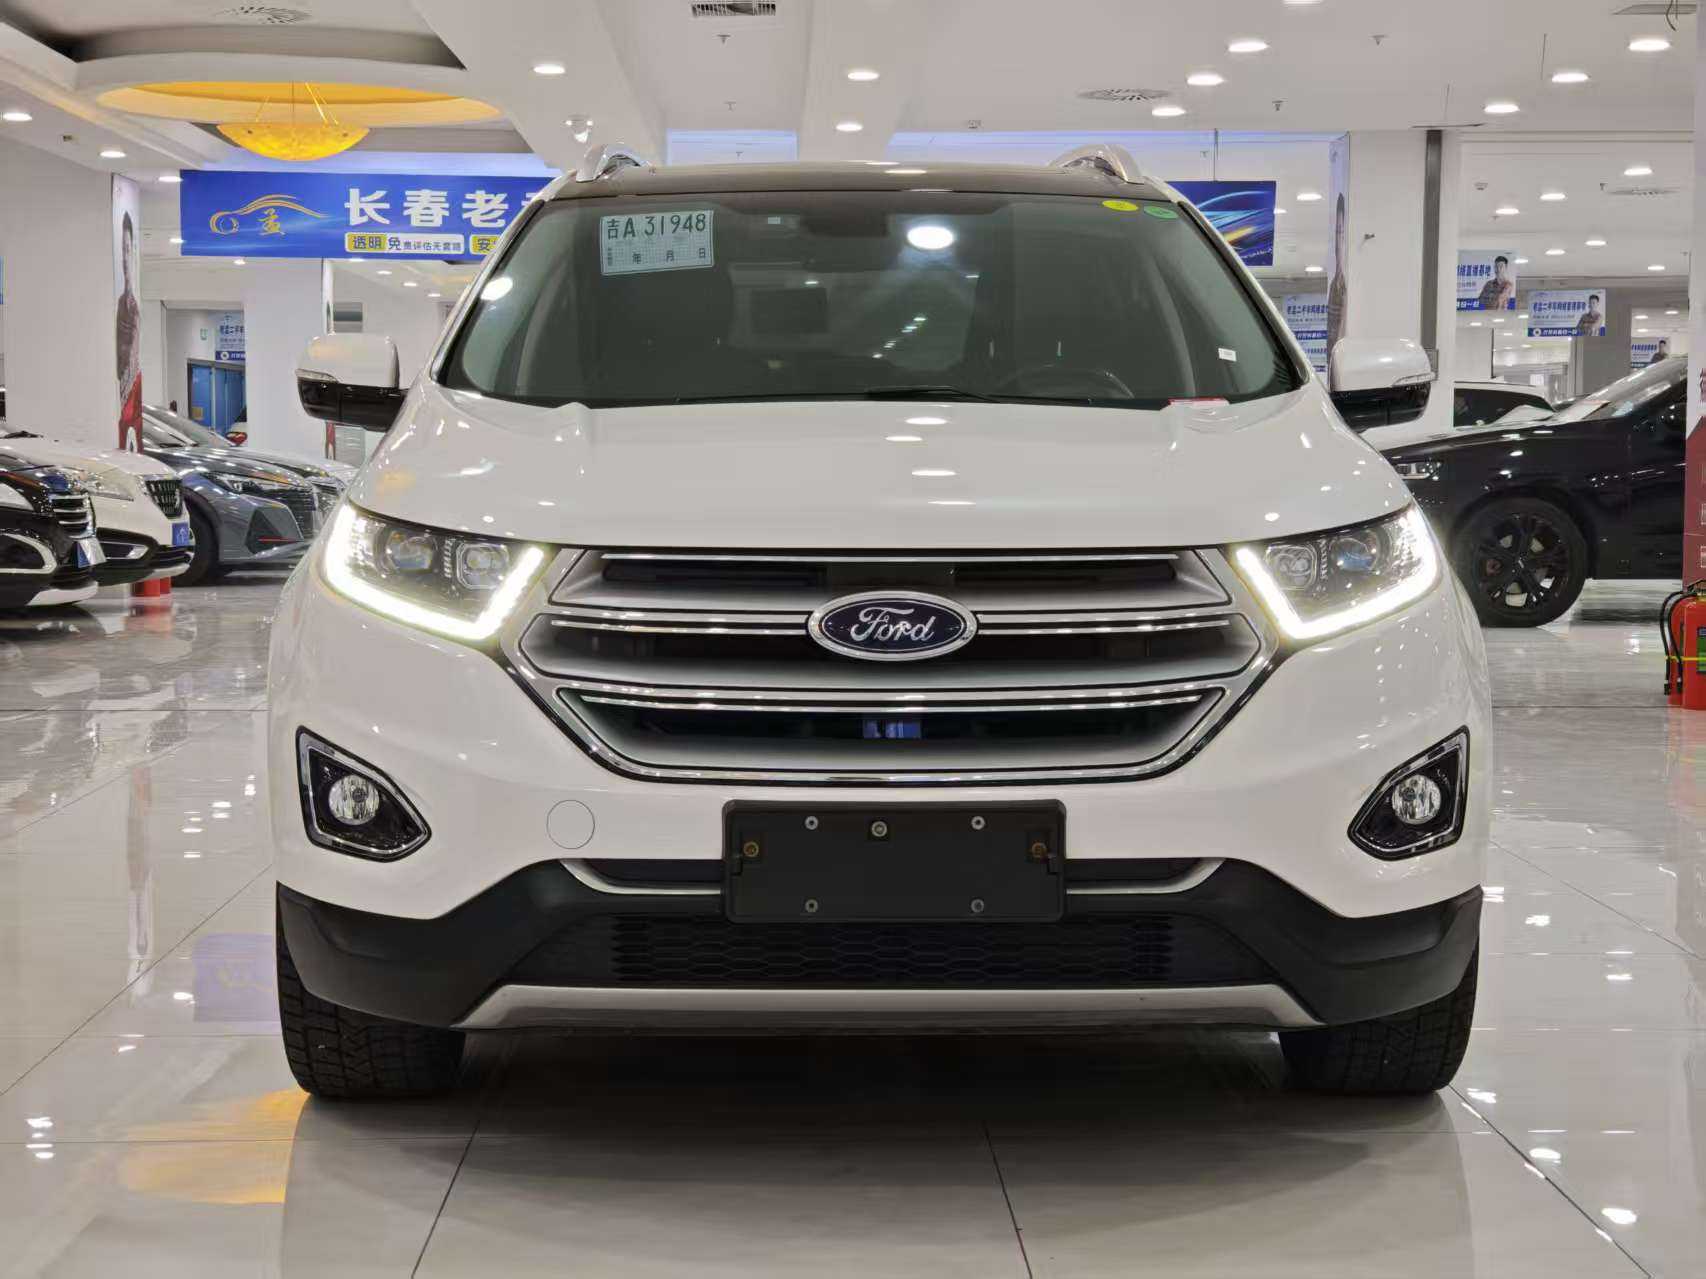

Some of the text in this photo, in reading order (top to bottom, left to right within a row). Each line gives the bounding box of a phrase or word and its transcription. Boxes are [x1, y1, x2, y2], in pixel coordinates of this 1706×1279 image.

[344, 188, 541, 228] 长春老
[850, 606, 937, 642] Ford
